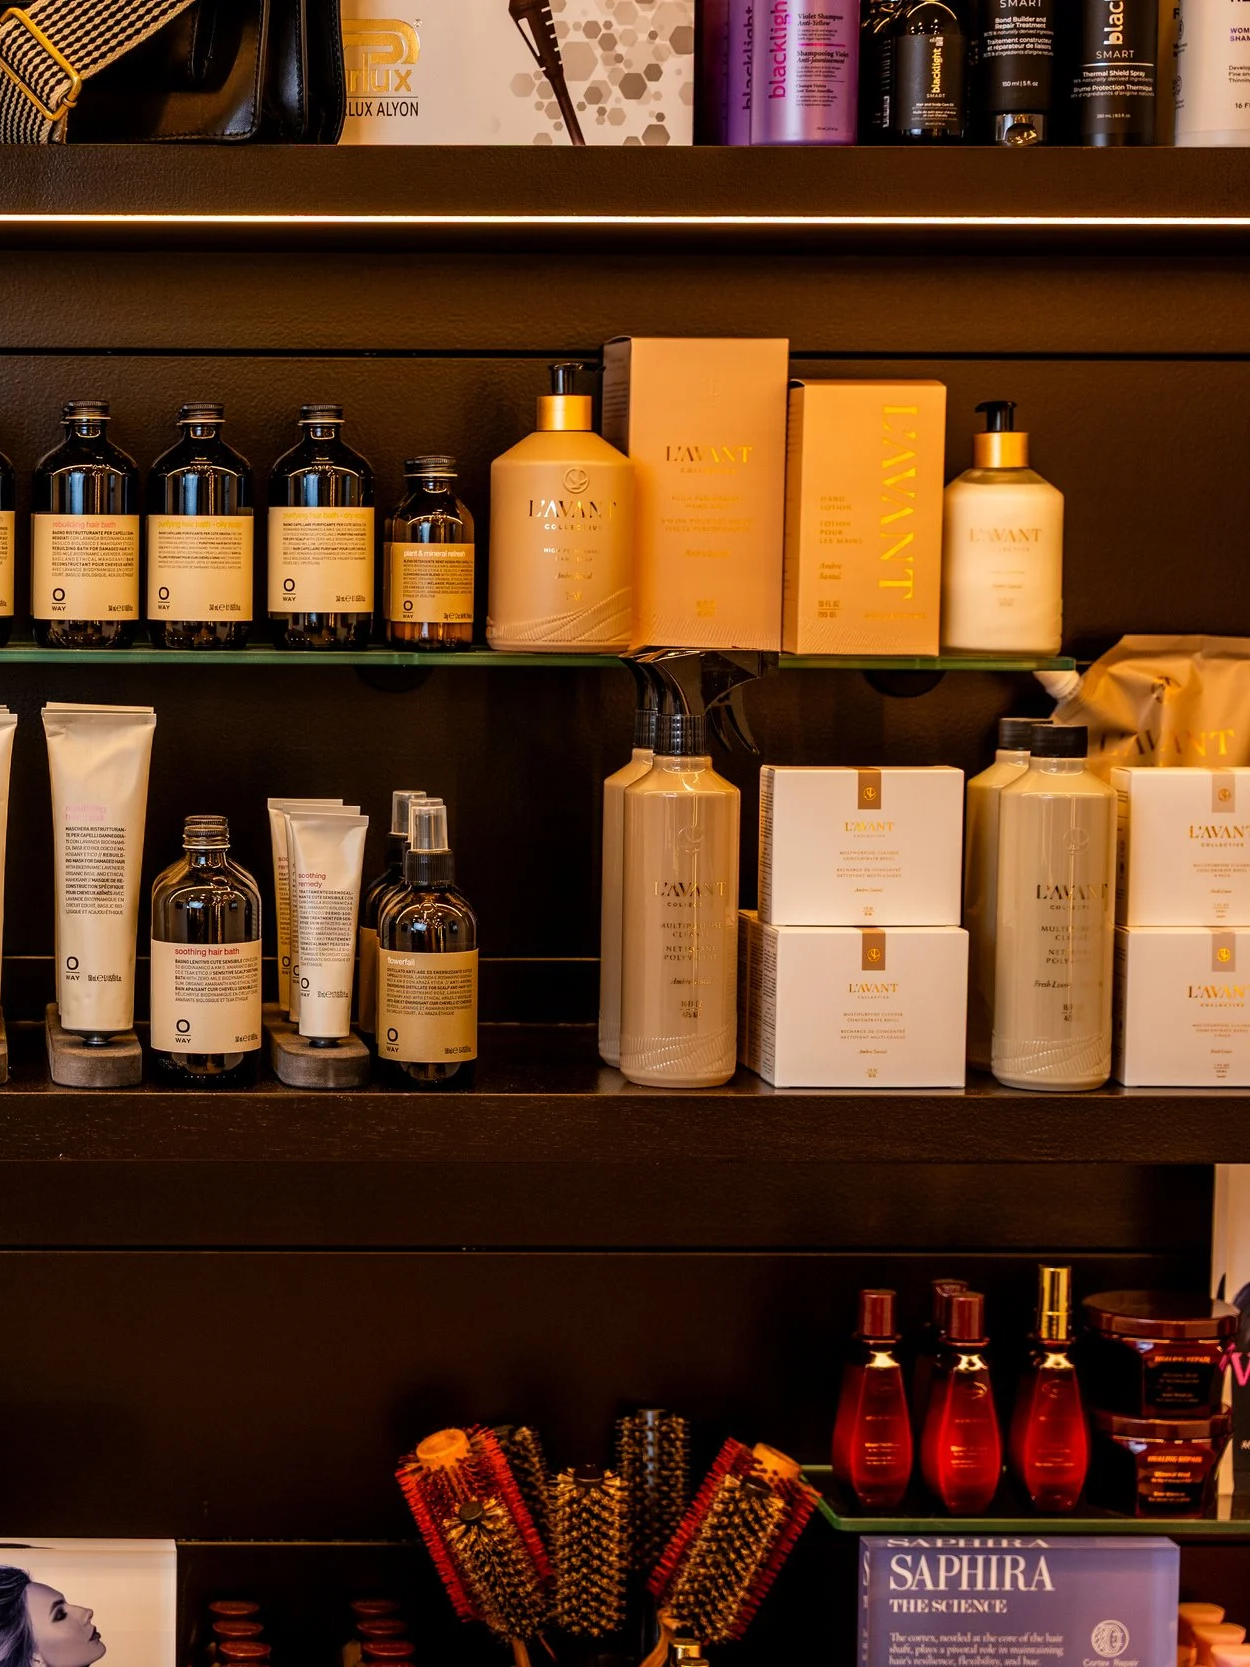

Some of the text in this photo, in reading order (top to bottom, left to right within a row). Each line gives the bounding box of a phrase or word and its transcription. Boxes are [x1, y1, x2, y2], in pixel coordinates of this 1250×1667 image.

[1104, 0, 1124, 45] blac
[768, 0, 790, 99] blackligh
[1096, 50, 1134, 59] SMART
[347, 53, 412, 92] rlux
[931, 48, 943, 93] blacklight
[344, 102, 418, 116] LUX ALYON
[666, 446, 752, 463] L'AVANT
[877, 405, 919, 600] L'AVANT
[284, 579, 295, 592] O
[53, 588, 65, 601] O
[159, 587, 169, 600] O
[404, 600, 413, 611] O
[845, 822, 895, 832] L'AVANT
[654, 881, 727, 897] L'AVANT
[175, 948, 206, 957] soothing
[66, 956, 79, 971] O
[301, 978, 309, 989] O
[849, 983, 898, 993] L'AVANT
[1034, 980, 1051, 988] Fresh
[176, 1019, 190, 1033] O
[387, 1028, 398, 1042] O
[886, 1538, 1051, 1548] SAPHIRA
[889, 1554, 1055, 1592] SAPHIRA
[889, 1598, 1007, 1613] THE SCIENCE
[890, 1632, 908, 1643] The
[940, 1633, 971, 1643] nestled
[973, 1634, 981, 1643] at
[983, 1633, 998, 1643] the
[999, 1634, 1018, 1643] core
[1020, 1632, 1030, 1643] of
[1030, 1633, 1044, 1643] the
[1046, 1632, 1063, 1643] hair
[889, 1645, 913, 1655] shaft,
[915, 1645, 938, 1657] plays
[946, 1645, 977, 1657] pivotal
[979, 1645, 997, 1655] role
[999, 1646, 1009, 1655] in
[1010, 1645, 1064, 1657] maintaining
[889, 1656, 911, 1666] hair's
[913, 1656, 956, 1667] resilience,
[958, 1656, 1002, 1667] flexibility,
[1004, 1656, 1020, 1666] and
